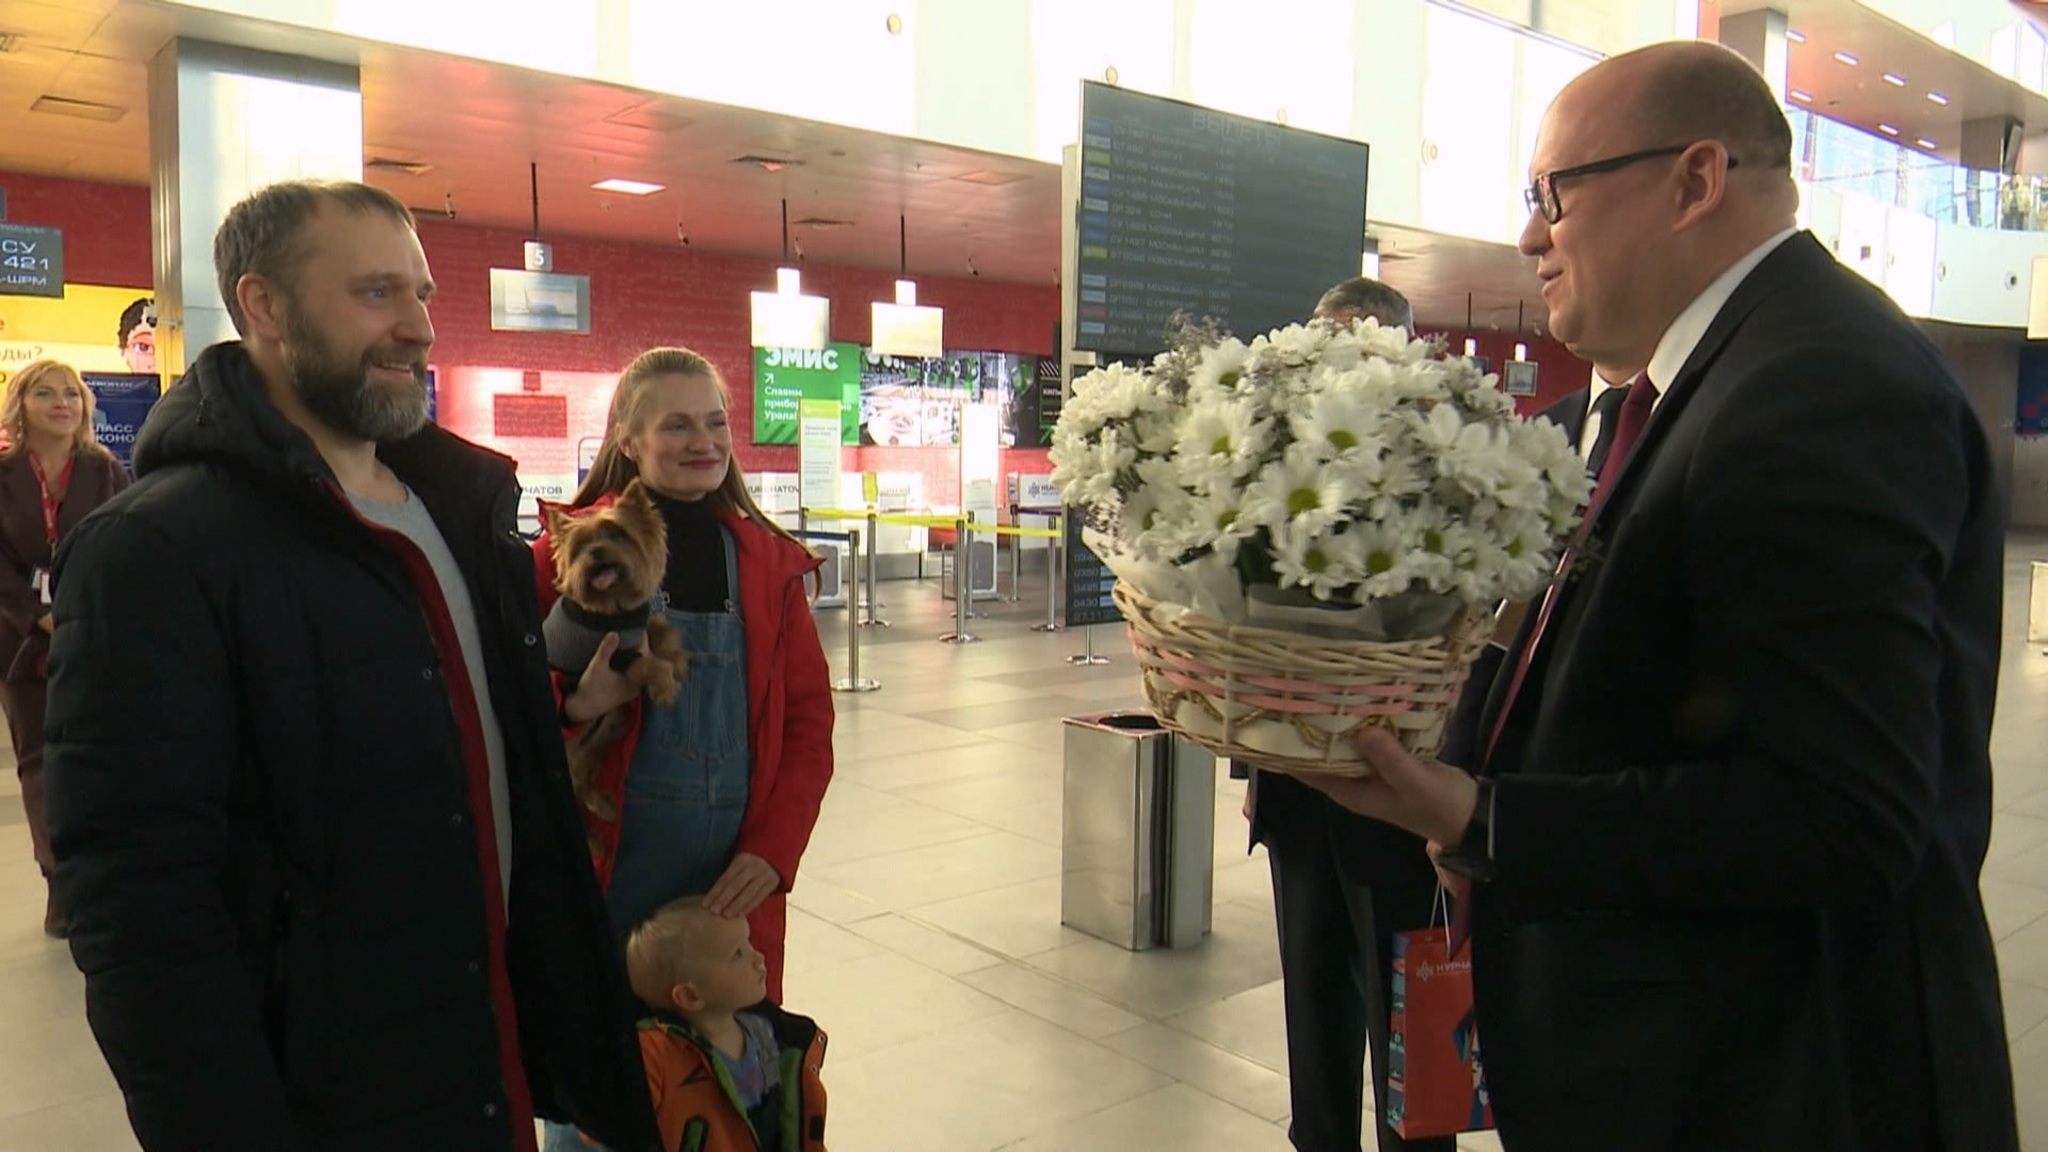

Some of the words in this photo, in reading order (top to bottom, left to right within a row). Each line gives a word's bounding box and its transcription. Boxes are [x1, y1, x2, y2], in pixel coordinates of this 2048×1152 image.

[2, 239, 37, 254] СУ
[533, 249, 545, 267] 5
[764, 347, 838, 371] ЭМИС
